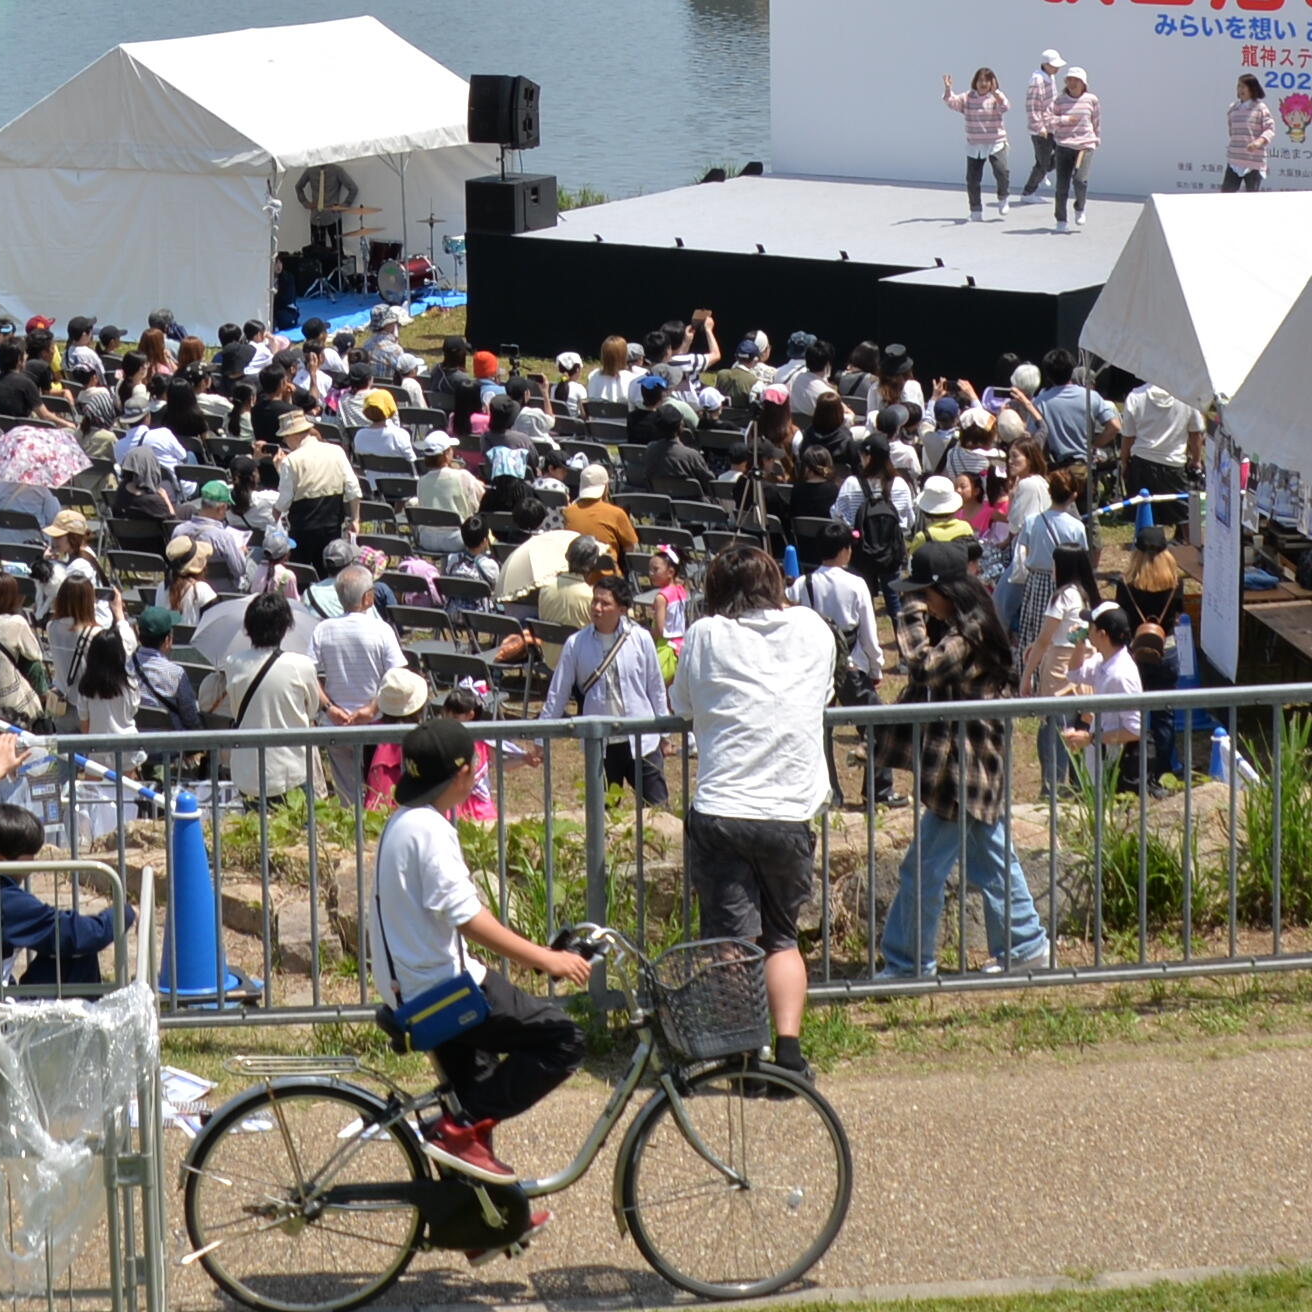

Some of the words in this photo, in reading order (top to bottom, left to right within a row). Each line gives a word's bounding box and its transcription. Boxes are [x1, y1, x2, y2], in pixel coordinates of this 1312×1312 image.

[1154, 14, 1297, 41] みらいを想い
